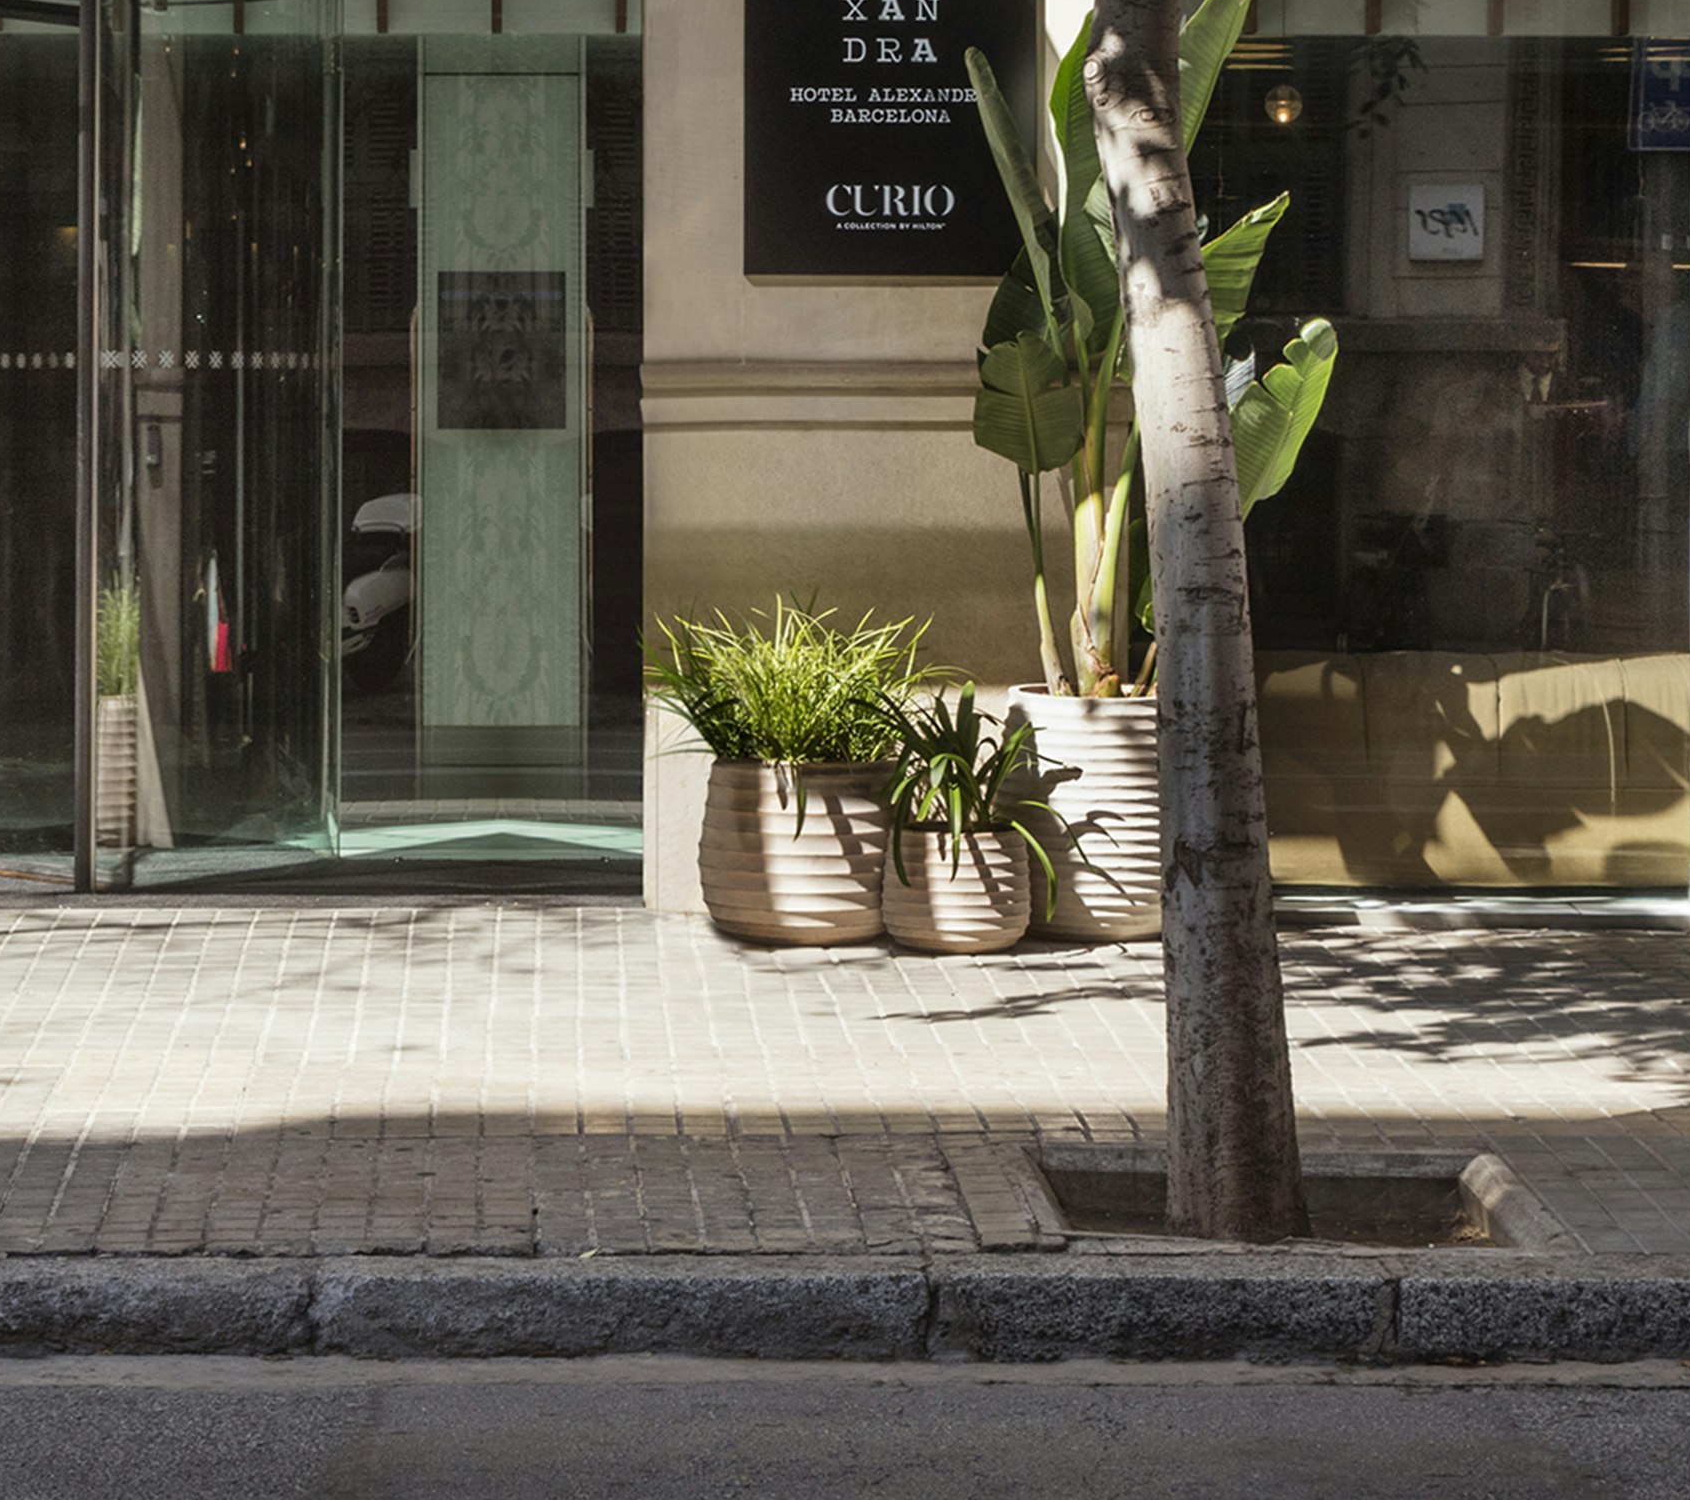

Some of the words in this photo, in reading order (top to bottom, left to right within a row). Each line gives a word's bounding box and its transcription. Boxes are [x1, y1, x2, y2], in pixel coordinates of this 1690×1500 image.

[842, 37, 938, 63] DRA
[790, 87, 858, 102] HOTEL
[867, 87, 977, 102] ALEXANDR
[830, 108, 951, 124] BARCELONA
[825, 184, 955, 217] CURIO
[836, 222, 843, 230] A
[843, 222, 897, 230] COLLECTION
[898, 222, 910, 230] BY
